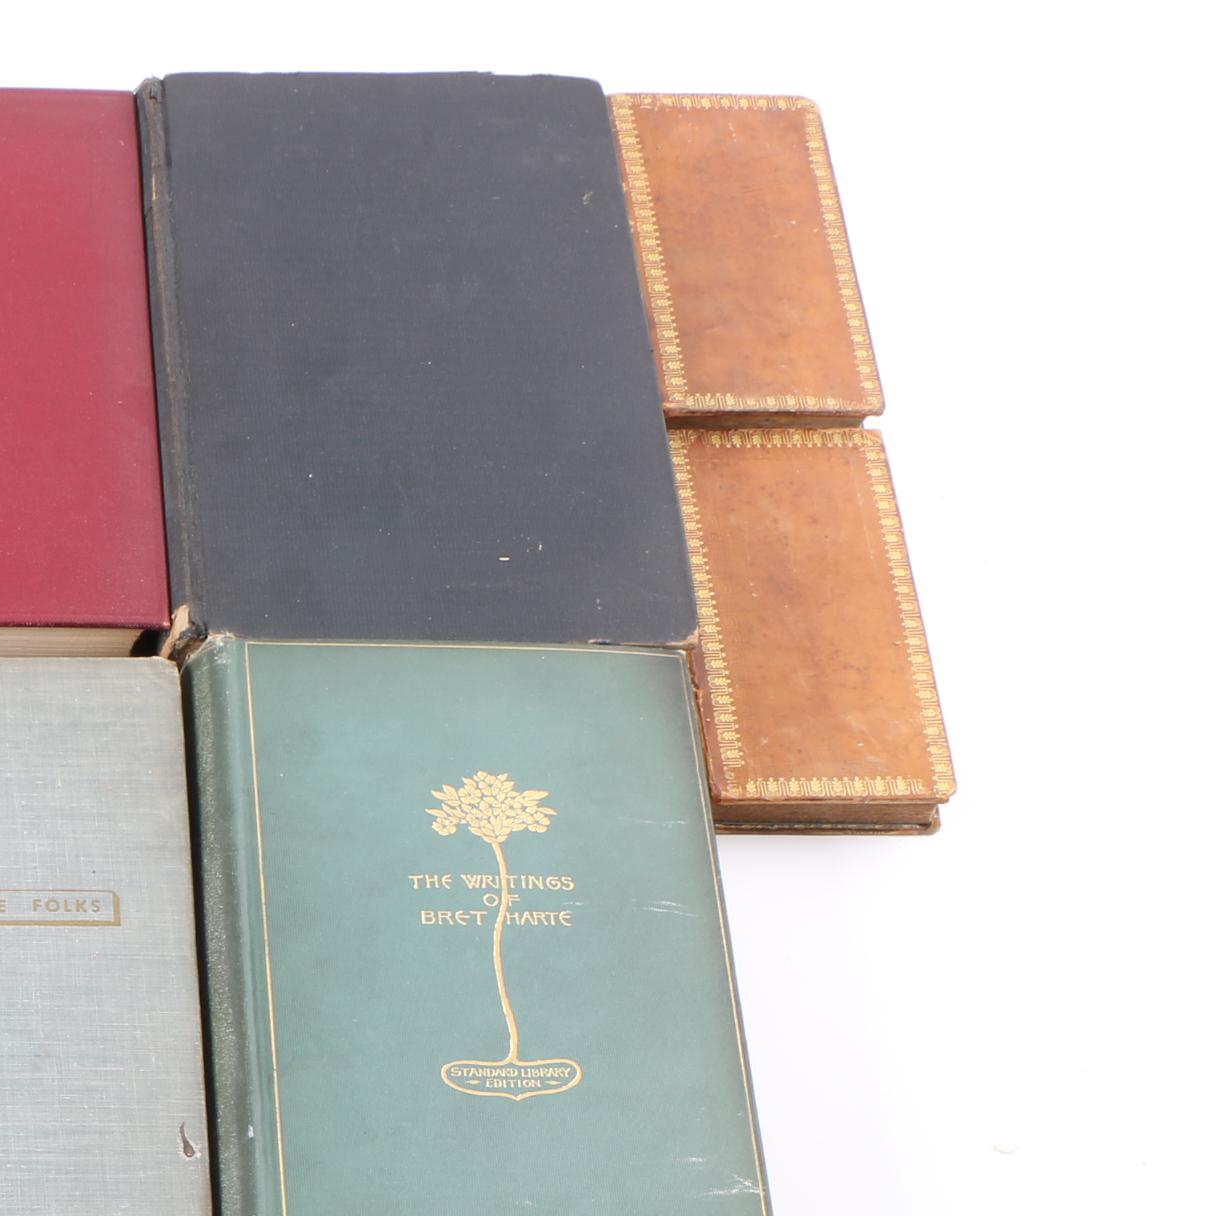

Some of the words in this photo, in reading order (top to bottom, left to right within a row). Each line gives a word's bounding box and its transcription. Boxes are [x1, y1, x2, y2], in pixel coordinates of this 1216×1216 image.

[408, 874, 453, 889] THE
[460, 874, 576, 891] WRITINGS
[32, 898, 102, 914] FOLKS
[482, 894, 521, 907] OF
[420, 910, 488, 926] BRET
[505, 911, 573, 926] HARTE
[450, 1066, 518, 1077] STANDARD
[521, 1066, 571, 1078] LIBRARY
[485, 1078, 541, 1088] EDITION
